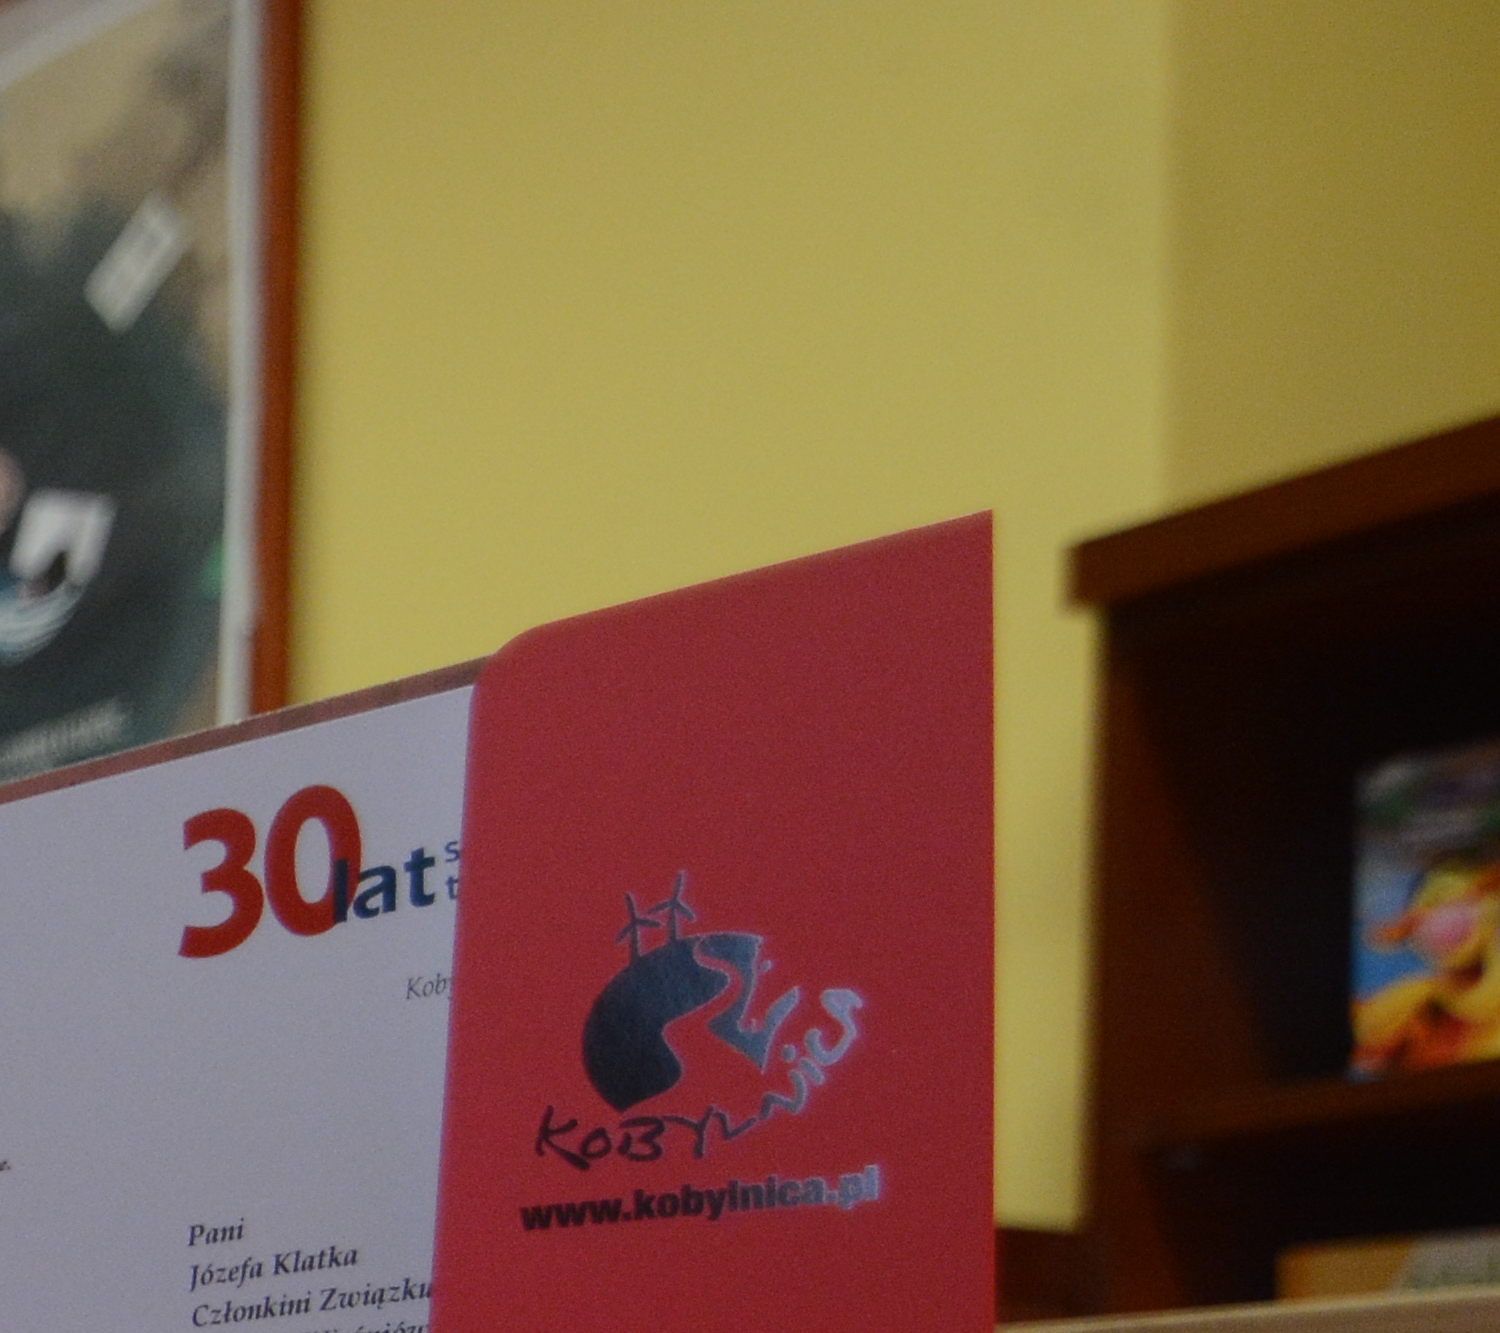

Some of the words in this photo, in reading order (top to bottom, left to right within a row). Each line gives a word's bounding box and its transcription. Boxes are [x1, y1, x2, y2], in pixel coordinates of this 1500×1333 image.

[405, 973, 451, 1002] Kob
[519, 1164, 881, 1233] www.kobylnica.pl
[189, 1218, 246, 1249] Pani
[191, 1257, 265, 1294] Józefa
[274, 1246, 360, 1277] Klatka
[192, 1291, 313, 1329] Członkini
[320, 1278, 433, 1313] Związku
